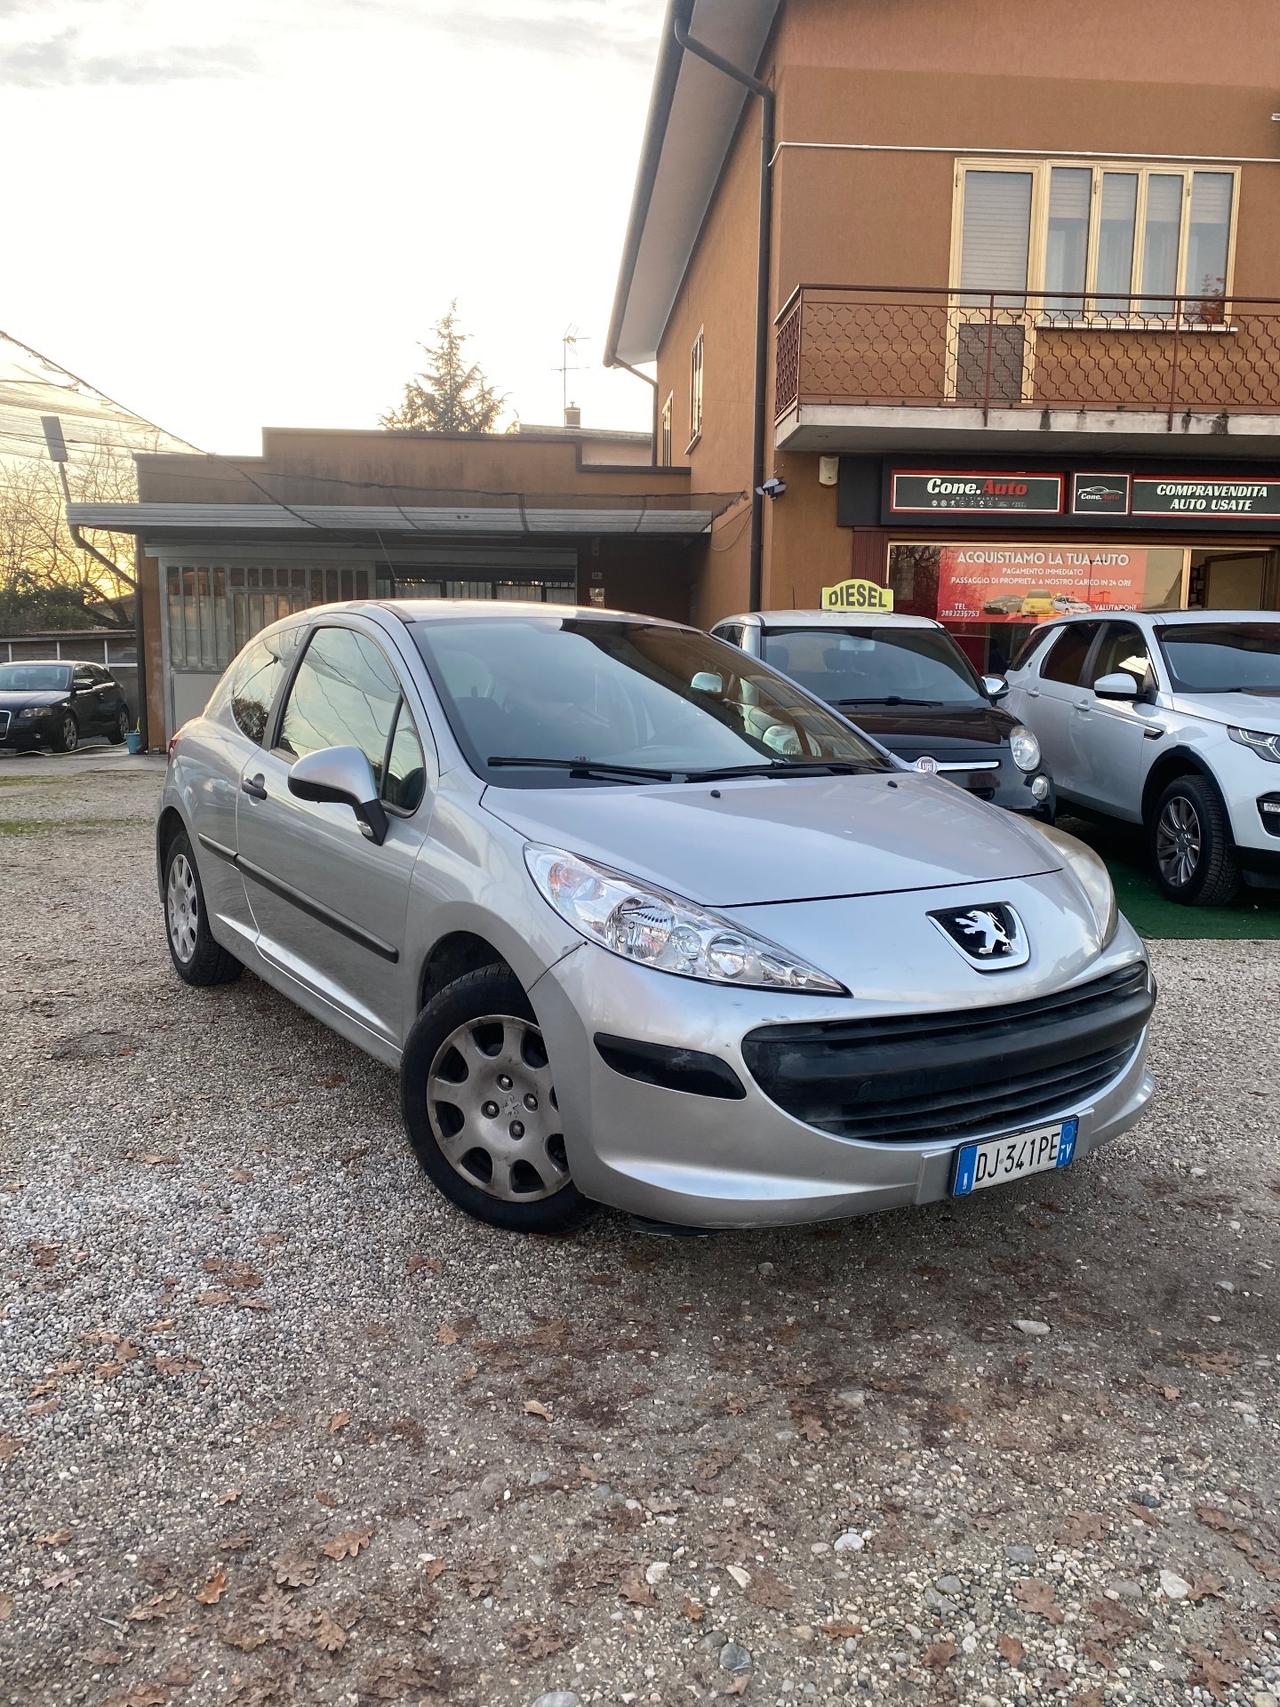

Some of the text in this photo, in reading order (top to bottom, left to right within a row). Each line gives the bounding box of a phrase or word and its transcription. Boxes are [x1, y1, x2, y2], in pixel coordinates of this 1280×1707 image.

[926, 478, 1029, 496] Cone.Auto
[1156, 484, 1268, 498] COMPRAVENDITA
[1169, 498, 1253, 511] AUTO USATE
[957, 551, 1130, 566] ACQUISTIAMO LA TUA AUTO
[1002, 567, 1084, 576] PAGAMENTO IMMEDIATO
[951, 576, 990, 584] PASSAGGIO
[991, 577, 999, 585] DI
[1044, 578, 1074, 586] NOSTRO
[828, 584, 887, 608] DIESEL
[975, 1132, 1061, 1182] DJ 341PE
[1059, 1142, 1073, 1160] TV
